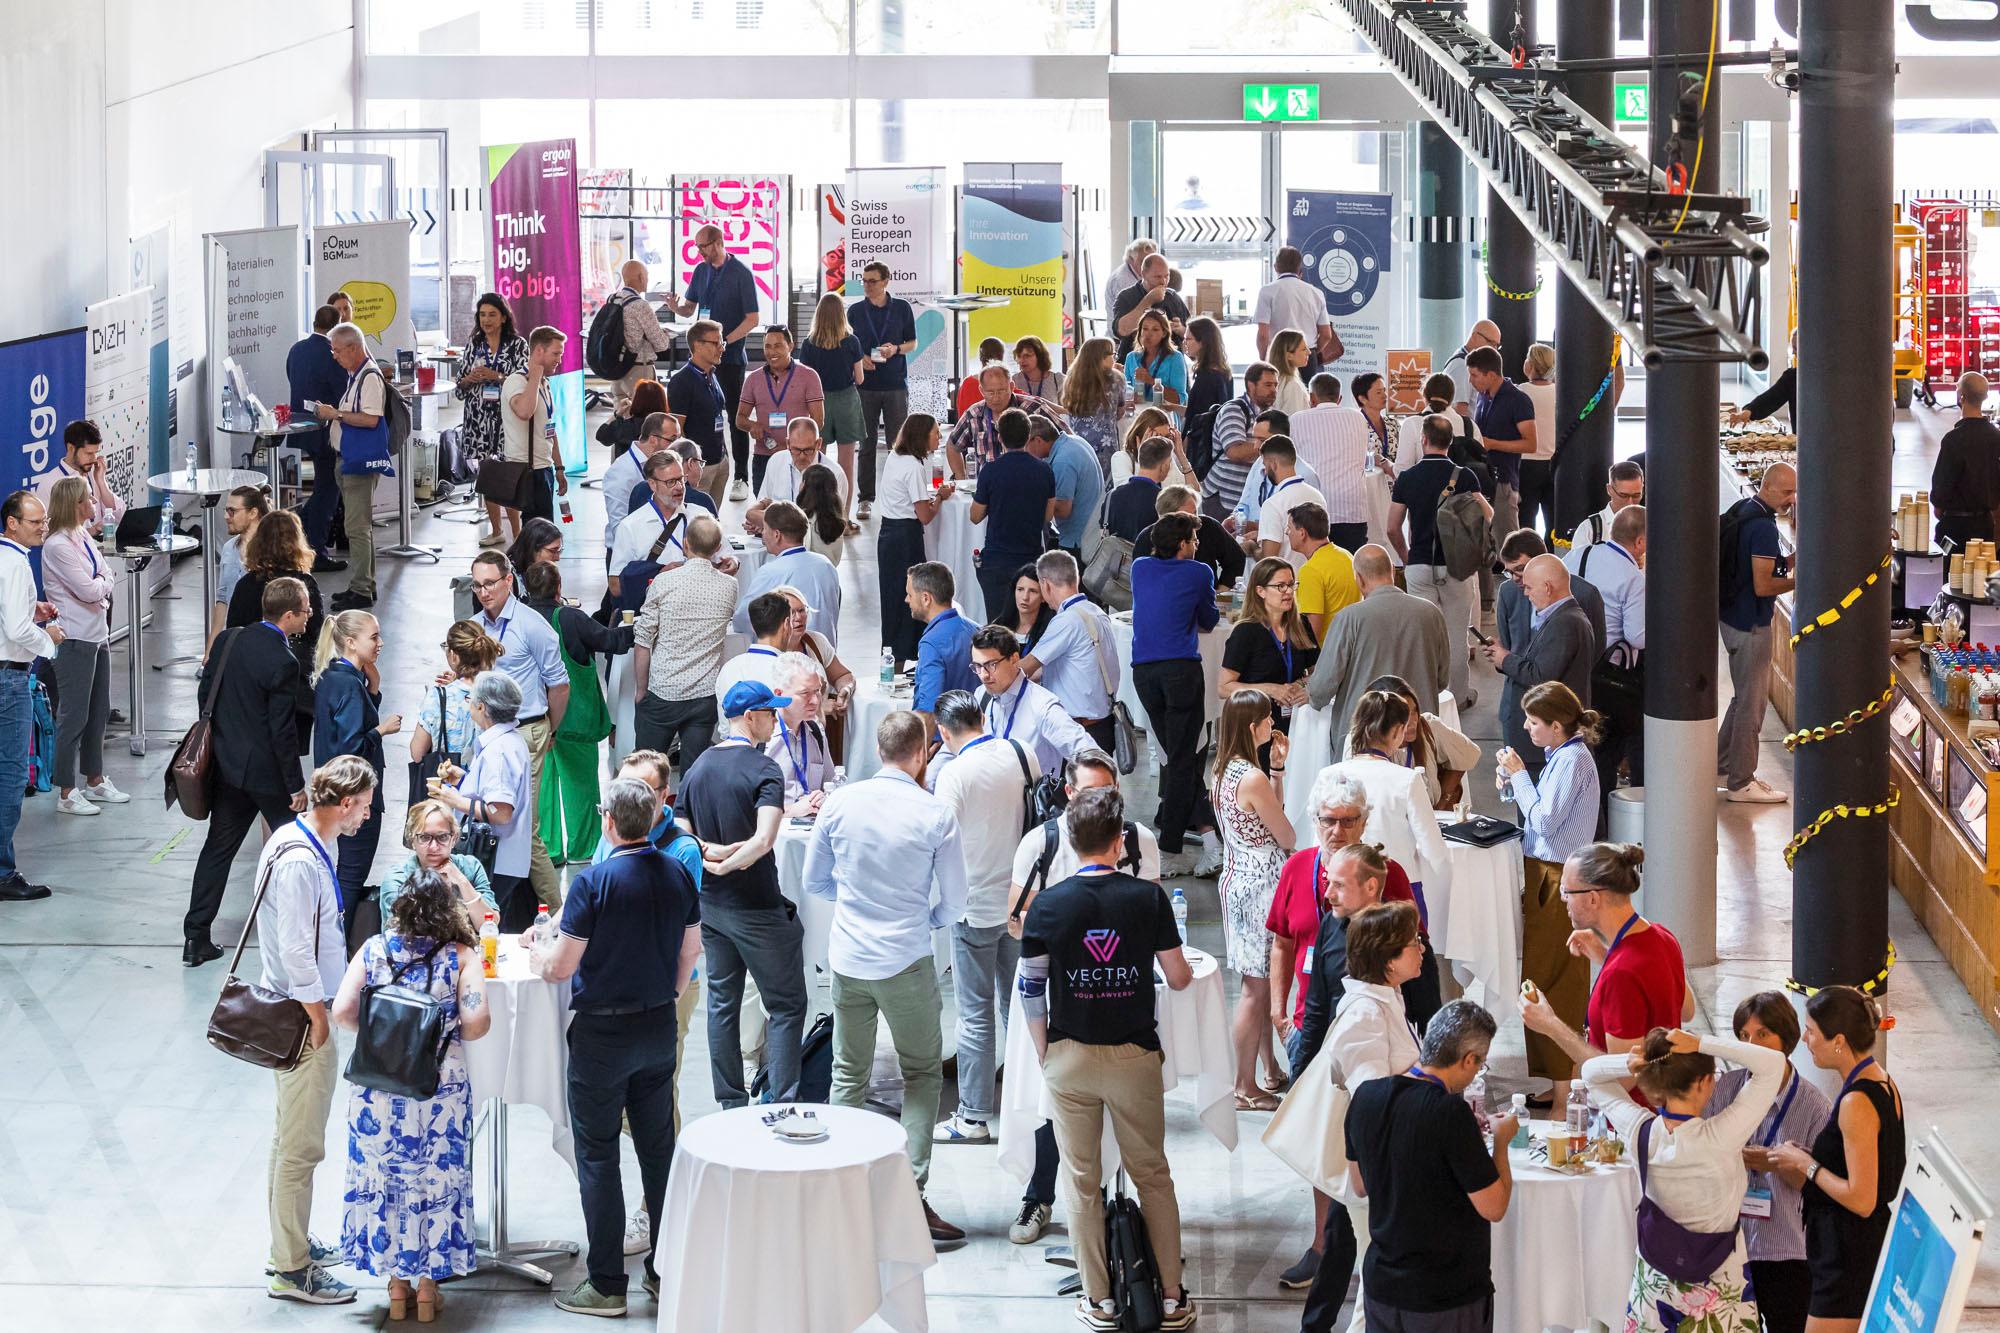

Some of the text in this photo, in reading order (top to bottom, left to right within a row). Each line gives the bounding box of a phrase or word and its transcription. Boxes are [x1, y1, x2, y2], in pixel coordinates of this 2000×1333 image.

[542, 149, 571, 164] ergon
[851, 200, 888, 211] Swiss
[1295, 197, 1309, 208] zh
[1292, 207, 1309, 216] aw
[495, 210, 546, 239] Think
[851, 214, 905, 225] Guide to
[851, 228, 911, 241] European
[970, 230, 1029, 241] Innovation
[851, 242, 910, 253] Research
[323, 250, 344, 260] BGM
[498, 243, 531, 272] big.
[851, 269, 917, 281] Intion
[1020, 273, 1056, 285] Unsere
[228, 275, 240, 288] nd
[498, 271, 560, 300] Go big.
[228, 290, 284, 305] echnologien
[976, 285, 1056, 299] Unterstützung
[239, 310, 259, 321] eine
[92, 319, 126, 355] DIZH
[1066, 966, 1139, 981] VECTRA
[1069, 979, 1138, 988] ADVISORS
